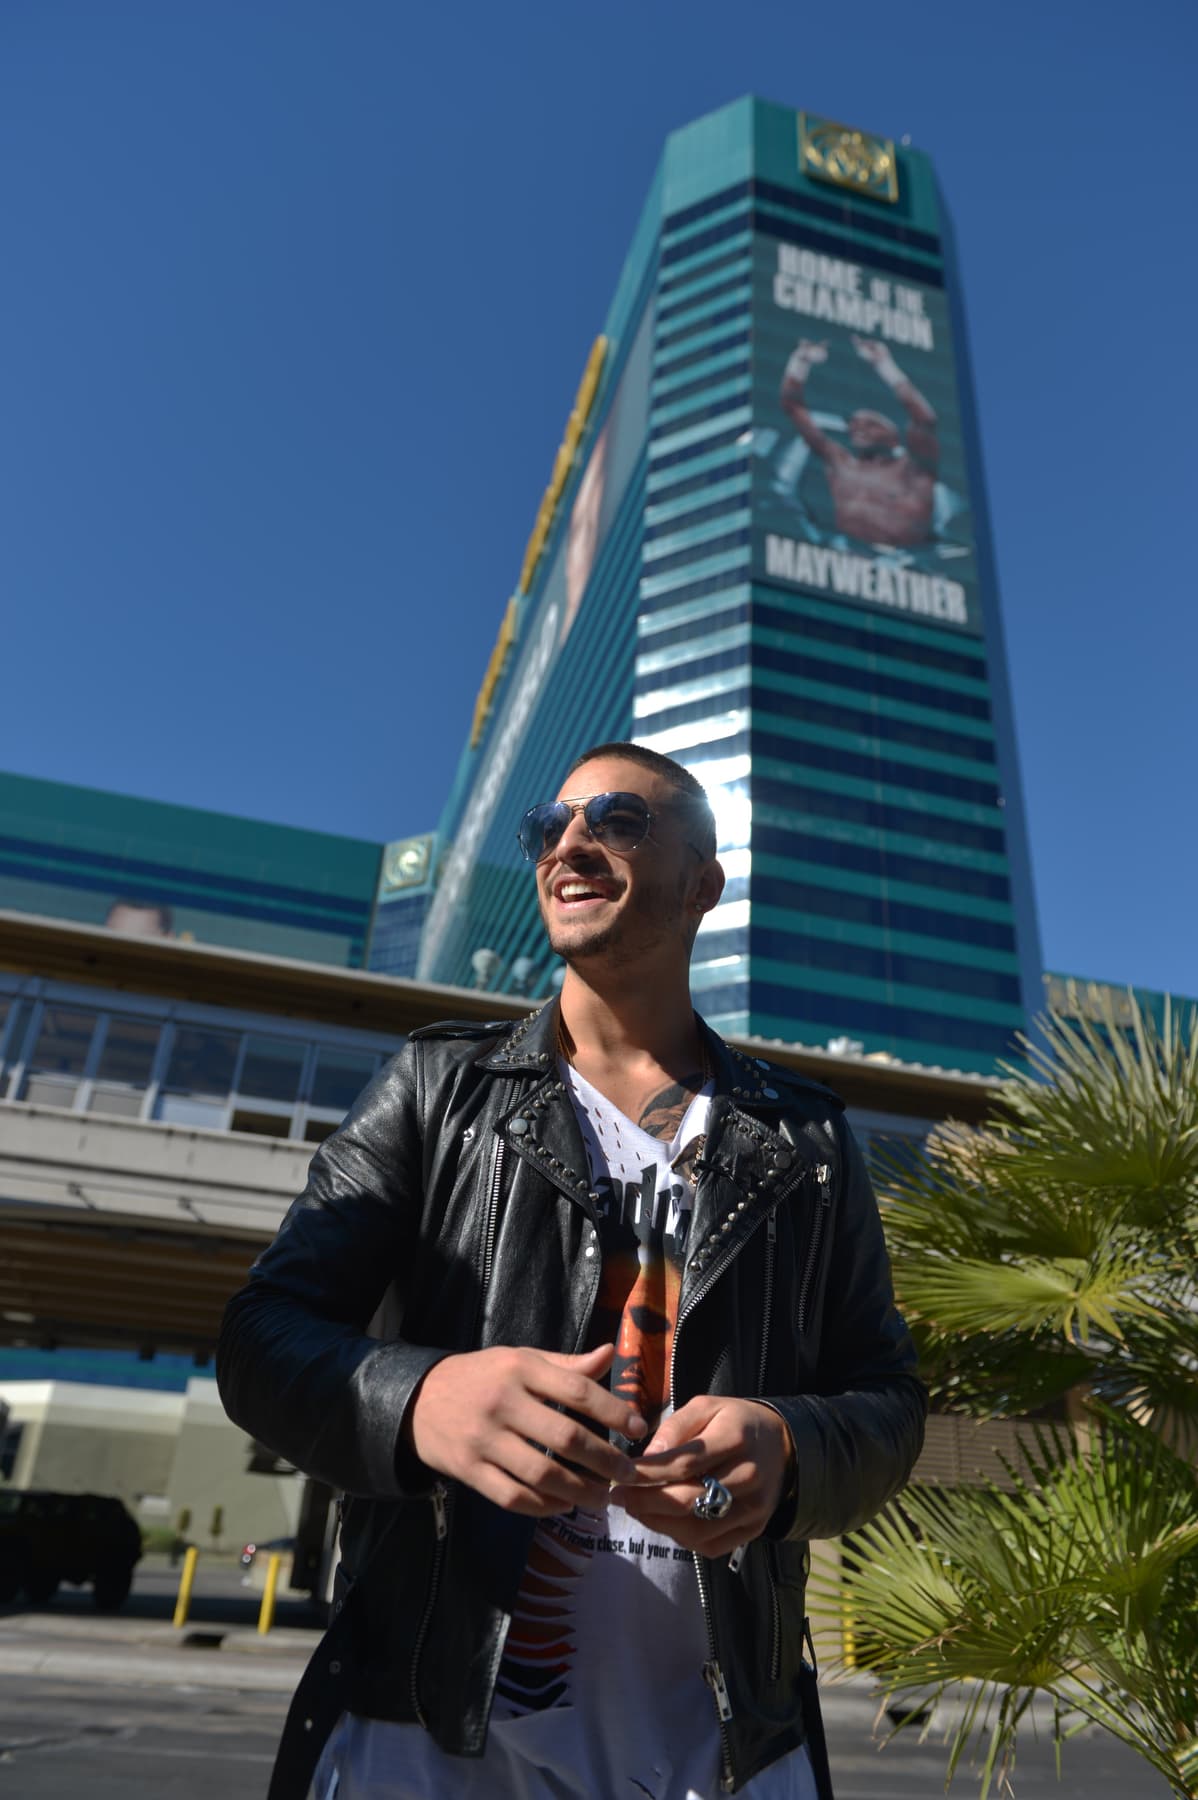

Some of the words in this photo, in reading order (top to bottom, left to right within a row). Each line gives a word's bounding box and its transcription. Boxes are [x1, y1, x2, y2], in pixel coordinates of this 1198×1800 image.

[777, 242, 863, 296] HOME
[773, 272, 934, 351] CHAMPION
[765, 534, 968, 625] MAYWEATHER
[598, 1535, 626, 1554] close,
[629, 1536, 645, 1555] but
[646, 1543, 671, 1560] your
